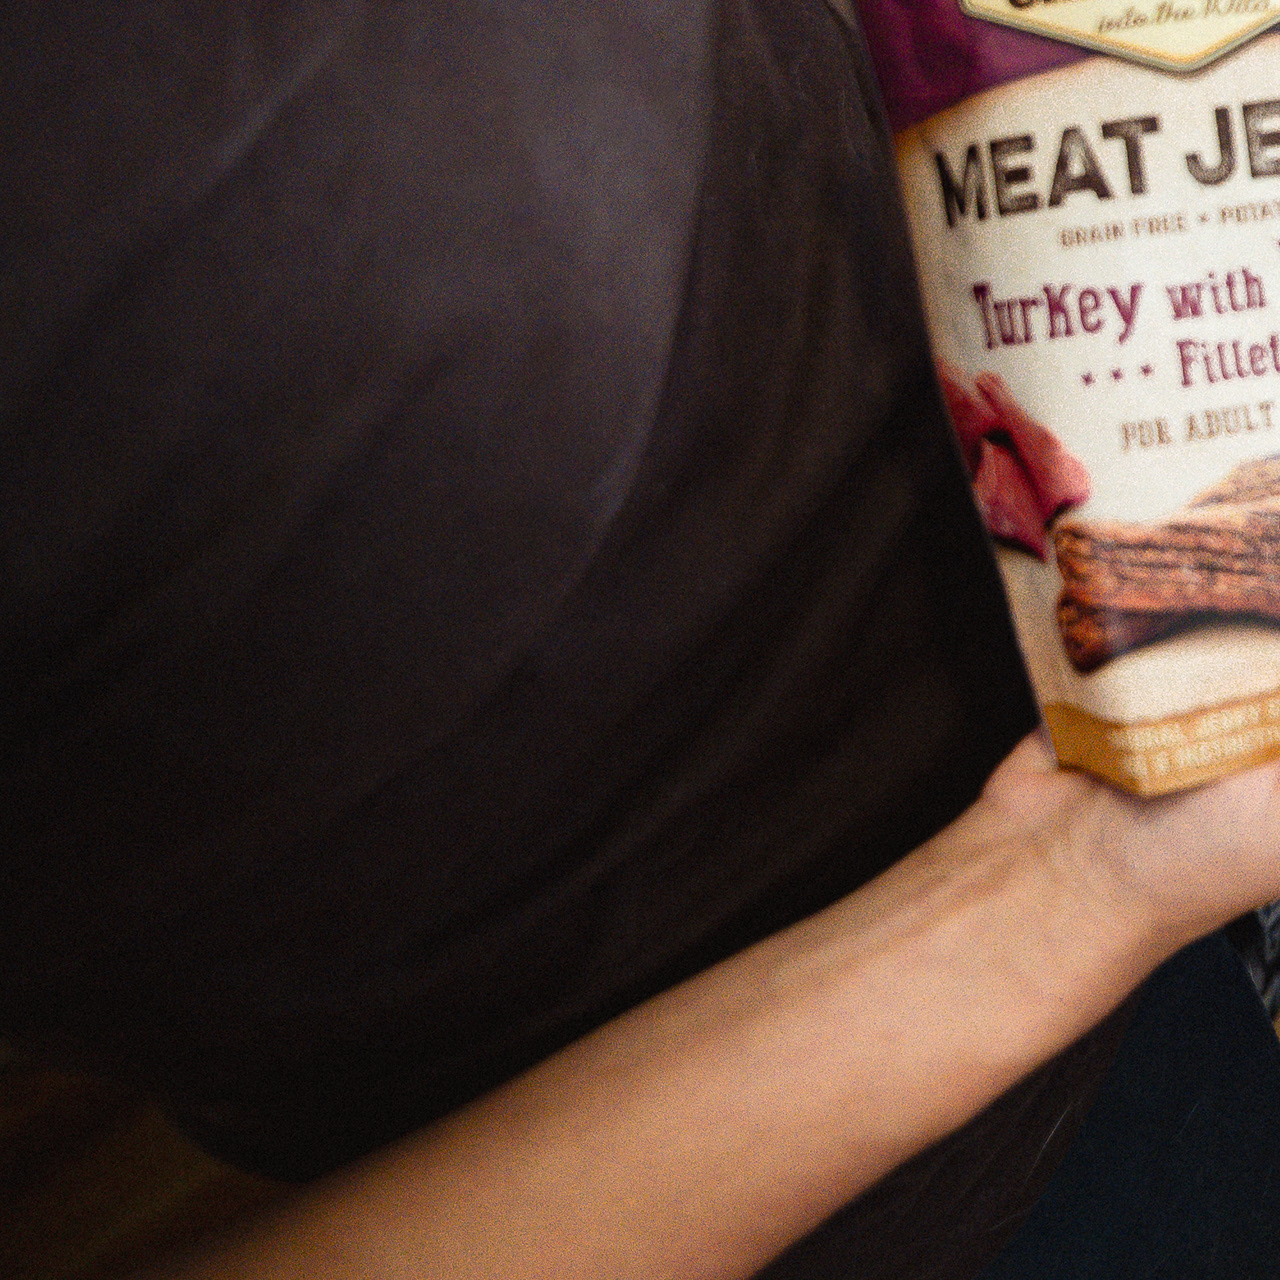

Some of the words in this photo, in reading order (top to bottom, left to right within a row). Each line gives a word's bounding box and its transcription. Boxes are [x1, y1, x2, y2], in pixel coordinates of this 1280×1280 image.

[1152, 0, 1191, 25] the
[933, 113, 1161, 228] MEAT
[1132, 212, 1188, 238] FREE
[1166, 266, 1266, 321] with
[1120, 416, 1173, 454] FOR
[1185, 400, 1276, 442] ADULT
